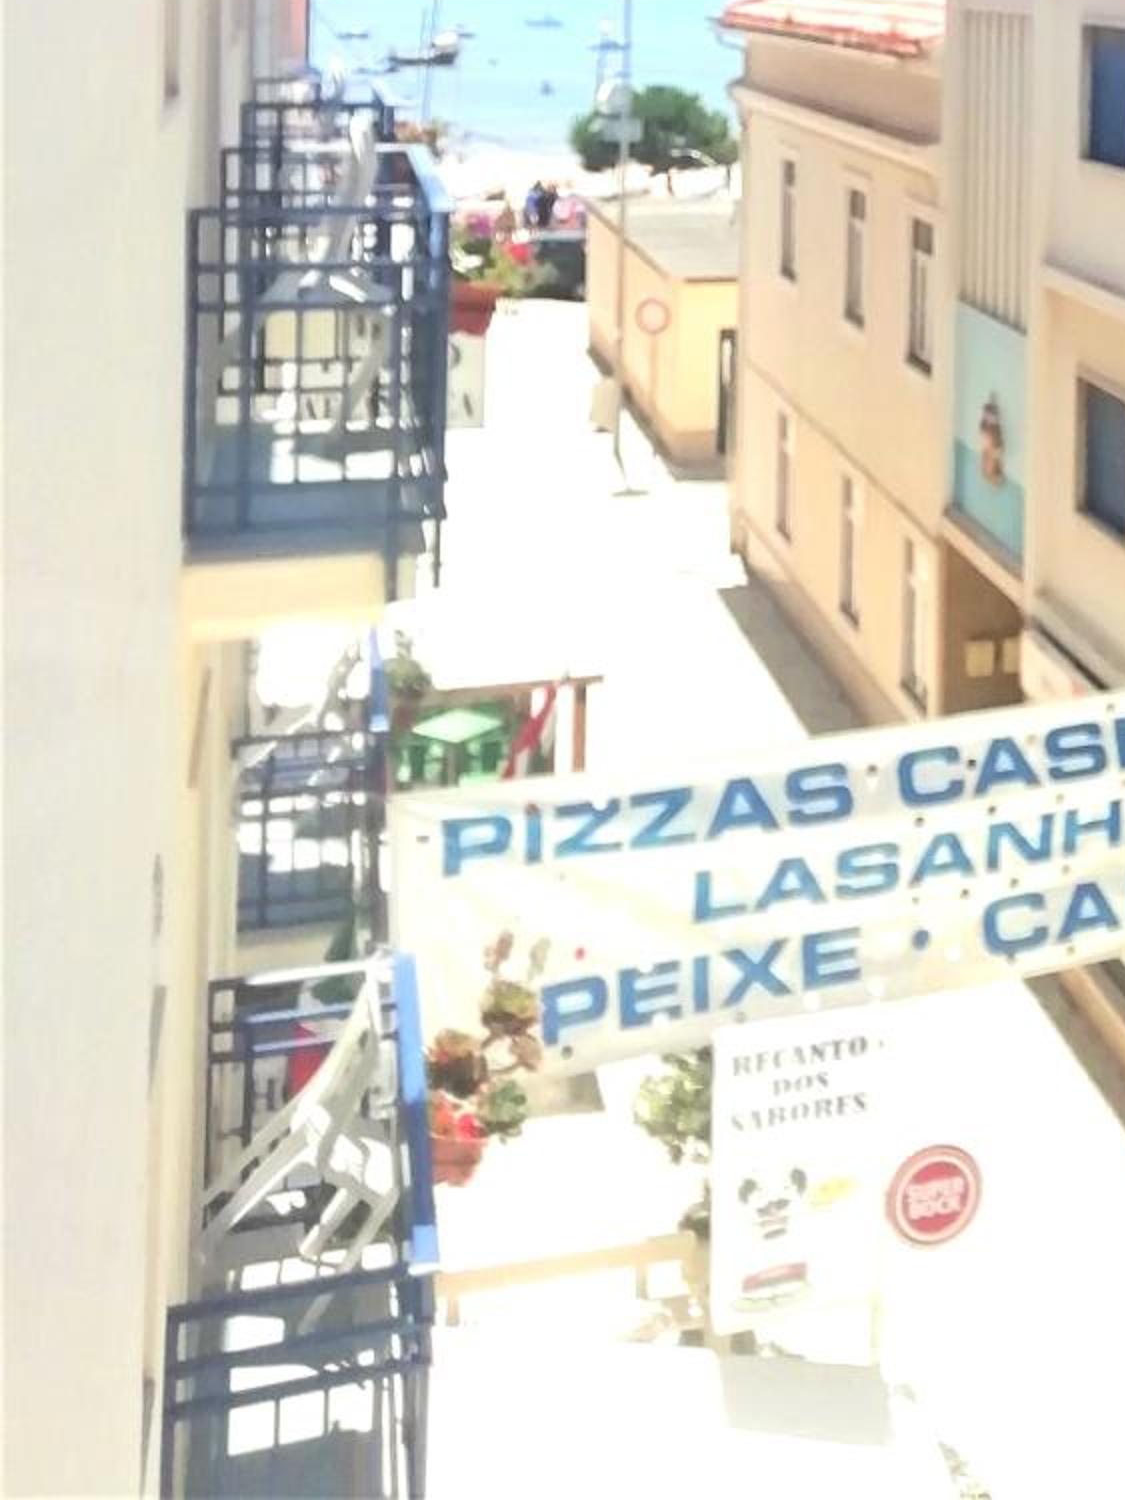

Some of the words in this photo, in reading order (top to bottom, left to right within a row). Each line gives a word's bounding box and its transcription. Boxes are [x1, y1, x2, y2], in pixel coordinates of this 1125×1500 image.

[441, 762, 855, 877] PIZZAS
[540, 926, 862, 1046] PEIXE
[731, 1034, 869, 1077] RECANTO
[772, 1070, 830, 1097] DOS
